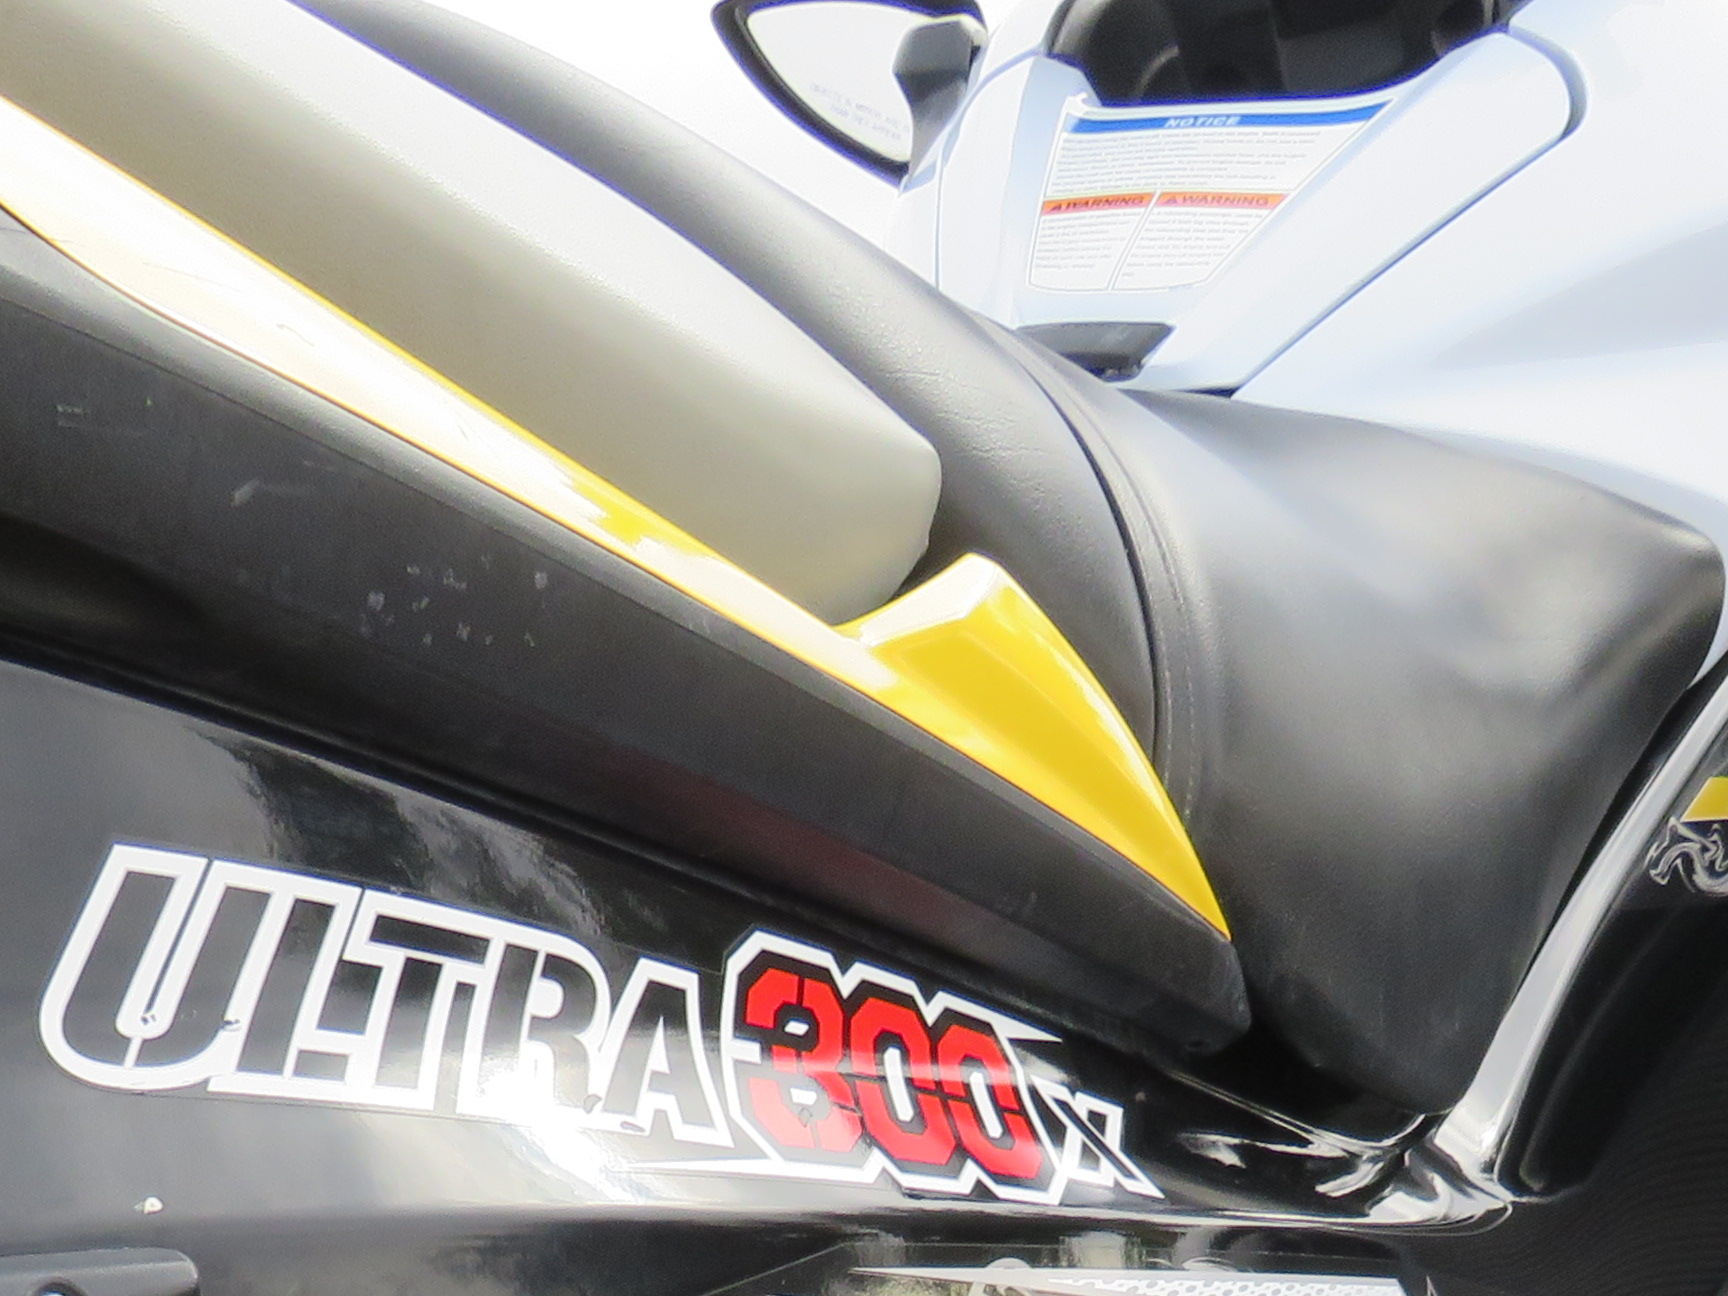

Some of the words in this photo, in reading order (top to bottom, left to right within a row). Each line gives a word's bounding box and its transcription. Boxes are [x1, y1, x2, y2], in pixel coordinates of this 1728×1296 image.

[1164, 116, 1242, 128] NOTICE
[1065, 195, 1145, 211] WARNING
[1180, 194, 1268, 207] WARNING
[39, 843, 737, 1149] ULTRA
